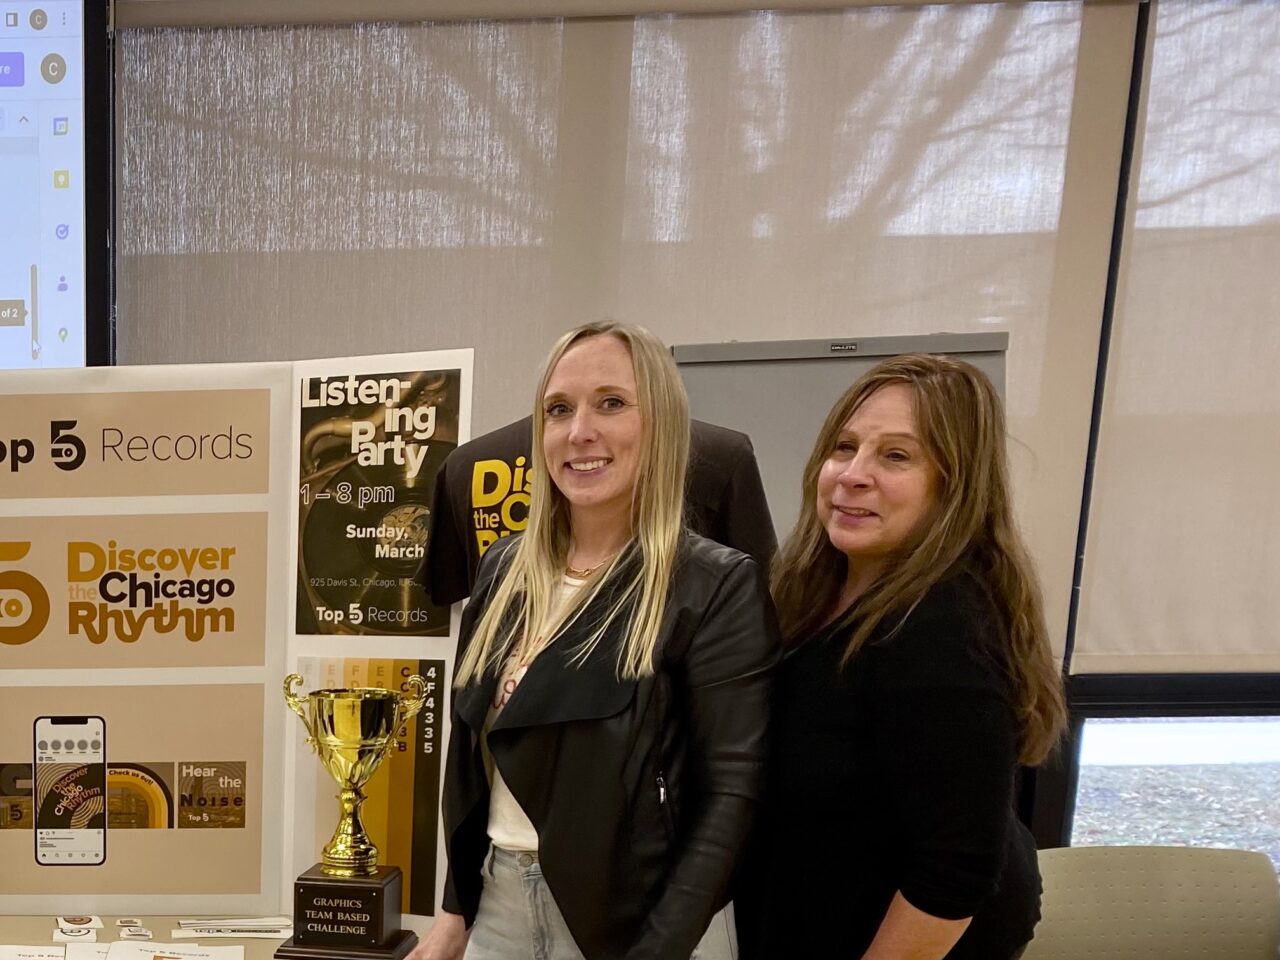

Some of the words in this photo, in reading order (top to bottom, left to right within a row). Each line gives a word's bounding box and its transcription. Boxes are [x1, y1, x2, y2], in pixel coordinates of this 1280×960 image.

[384, 398, 438, 440] ing
[50, 420, 87, 471] 5
[101, 425, 254, 462] Records
[350, 420, 429, 480] Party
[300, 483, 310, 505] 1
[336, 482, 353, 505] 8
[358, 484, 396, 509] pm
[473, 509, 500, 529] the
[345, 524, 410, 542] Sunday,
[375, 543, 425, 559] March
[67, 540, 236, 583] Discover
[98, 571, 236, 608] Chicago
[327, 577, 349, 588] Davis
[68, 584, 97, 601] the
[68, 600, 236, 645] Rhythm
[316, 606, 344, 625] Top
[348, 603, 365, 626] 5
[368, 606, 429, 624] Records
[52, 767, 90, 794] Discover
[182, 764, 217, 778] Hear
[218, 775, 242, 788] the
[179, 793, 244, 807] Noise
[312, 897, 363, 909] GRAPHICS
[305, 909, 336, 921] TEAM
[337, 910, 370, 923] BASED
[307, 923, 367, 936] CHALLENGE
